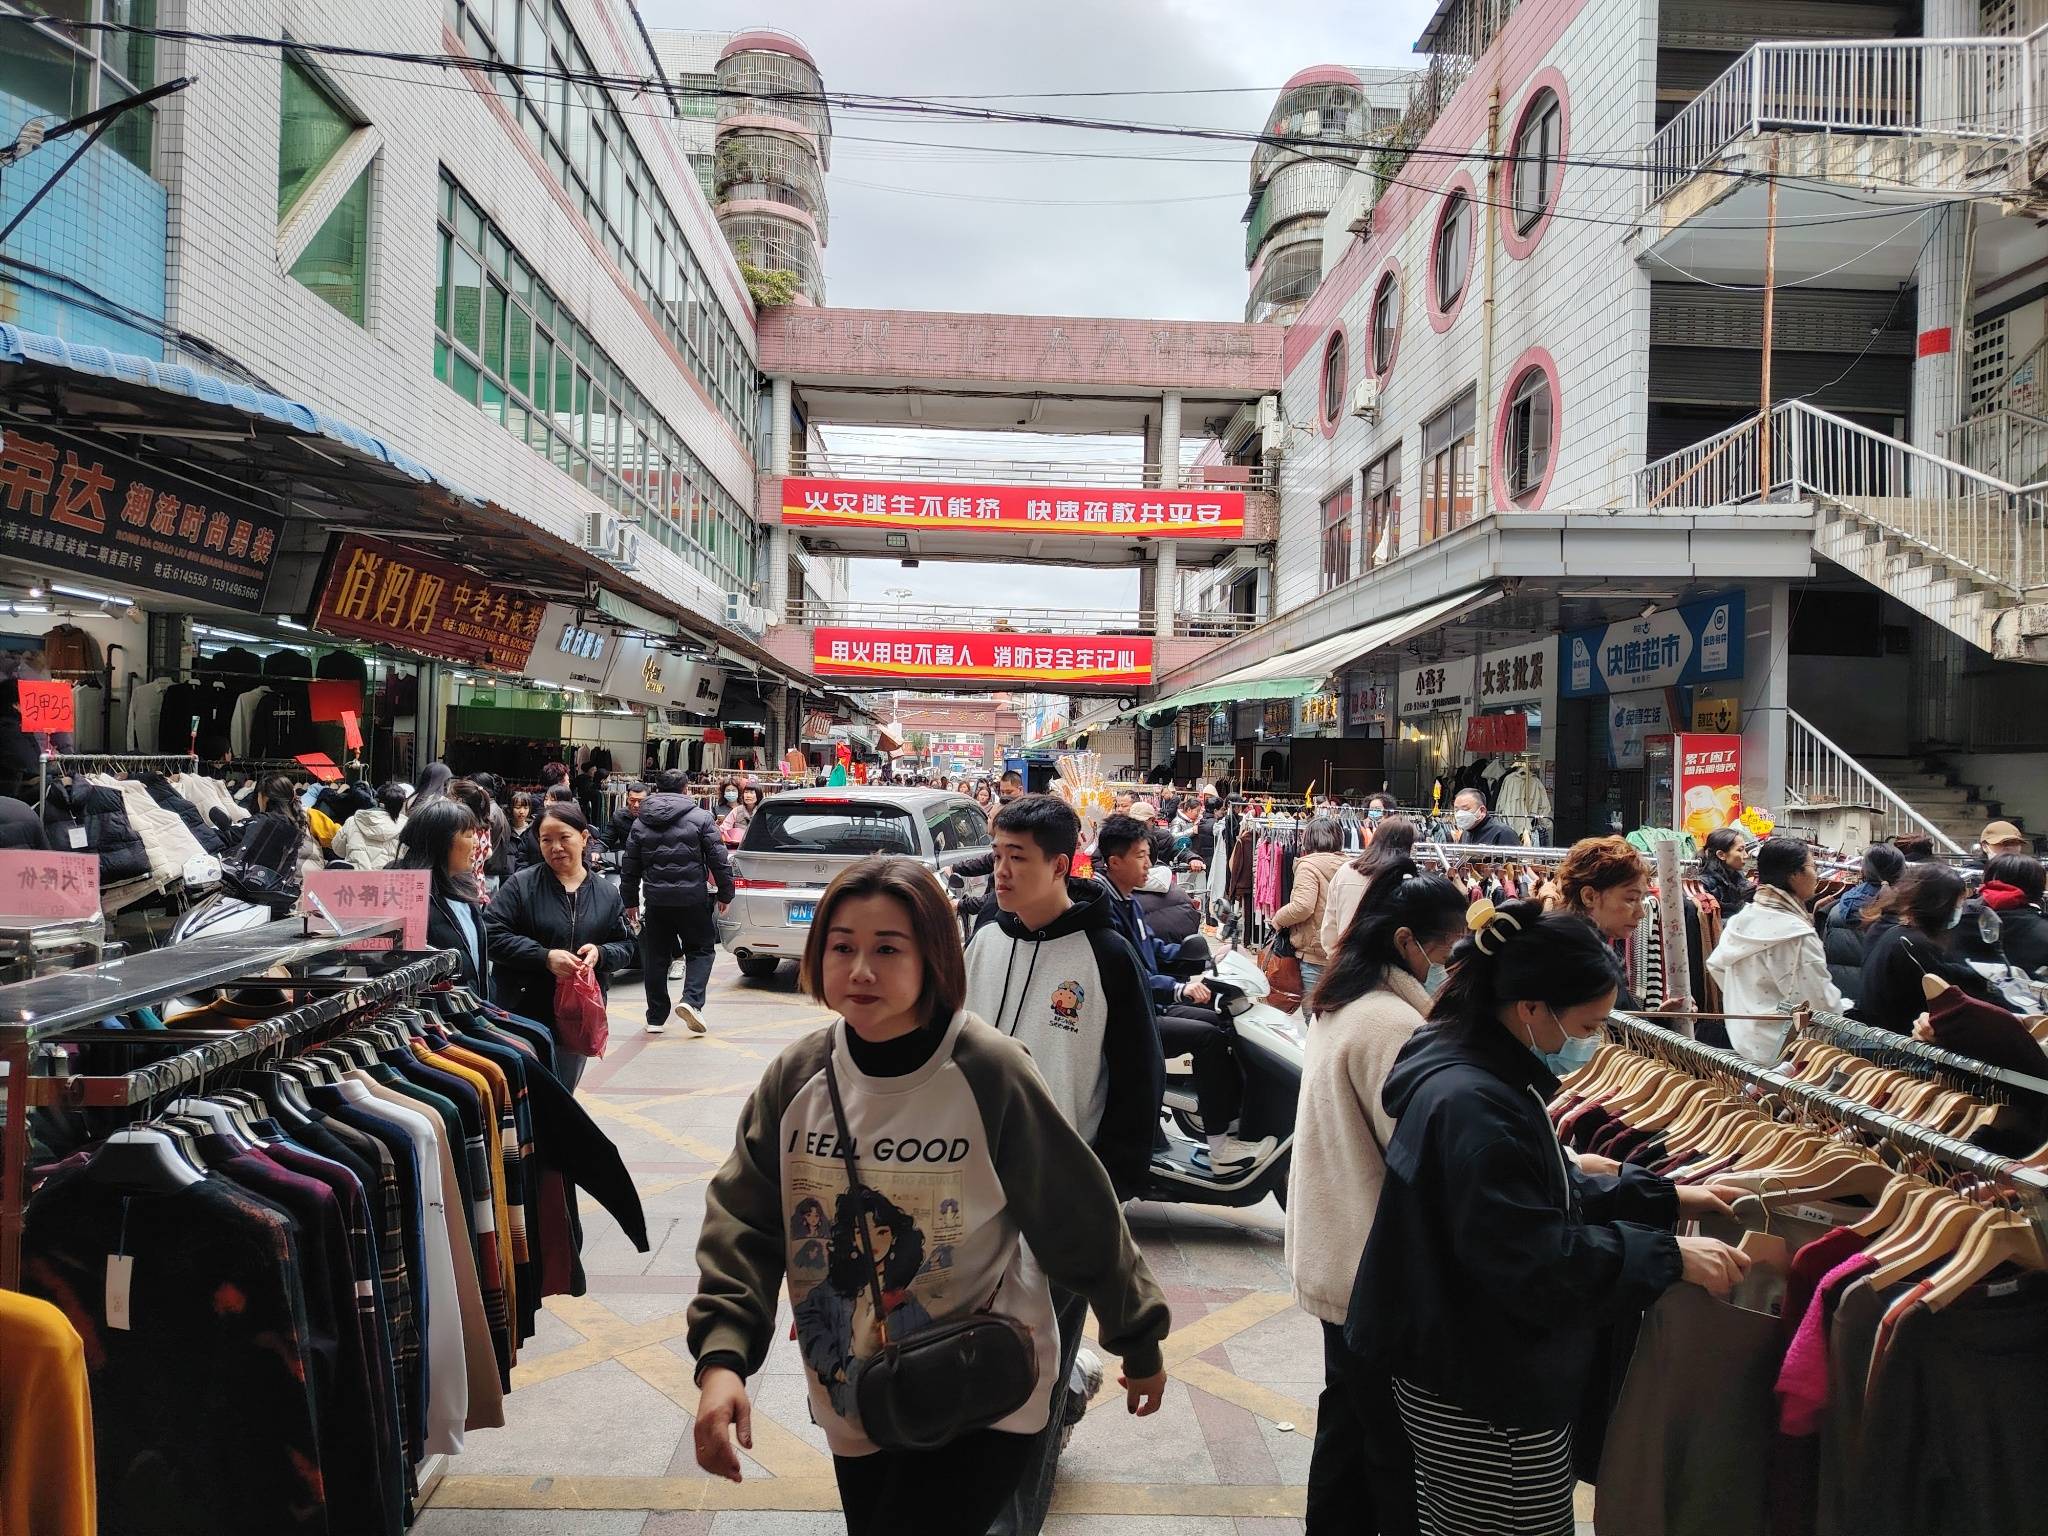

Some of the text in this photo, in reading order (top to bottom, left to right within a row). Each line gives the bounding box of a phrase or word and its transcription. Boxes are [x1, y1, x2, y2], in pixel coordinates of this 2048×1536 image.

[120, 480, 275, 565] 潮流时尚男装
[804, 491, 1222, 525] 火灾逃生不能挤 快速疏散共平安
[335, 547, 445, 635] 俏妈妈
[831, 640, 1135, 672] 用火用电不离人 消防安全牢记心
[1416, 651, 1544, 697] 小燕子 女装批发
[1607, 633, 1681, 677] 快递超市
[1684, 749, 1737, 766] 累了困了
[788, 1130, 799, 1153] I
[873, 1137, 970, 1163] GOOD
